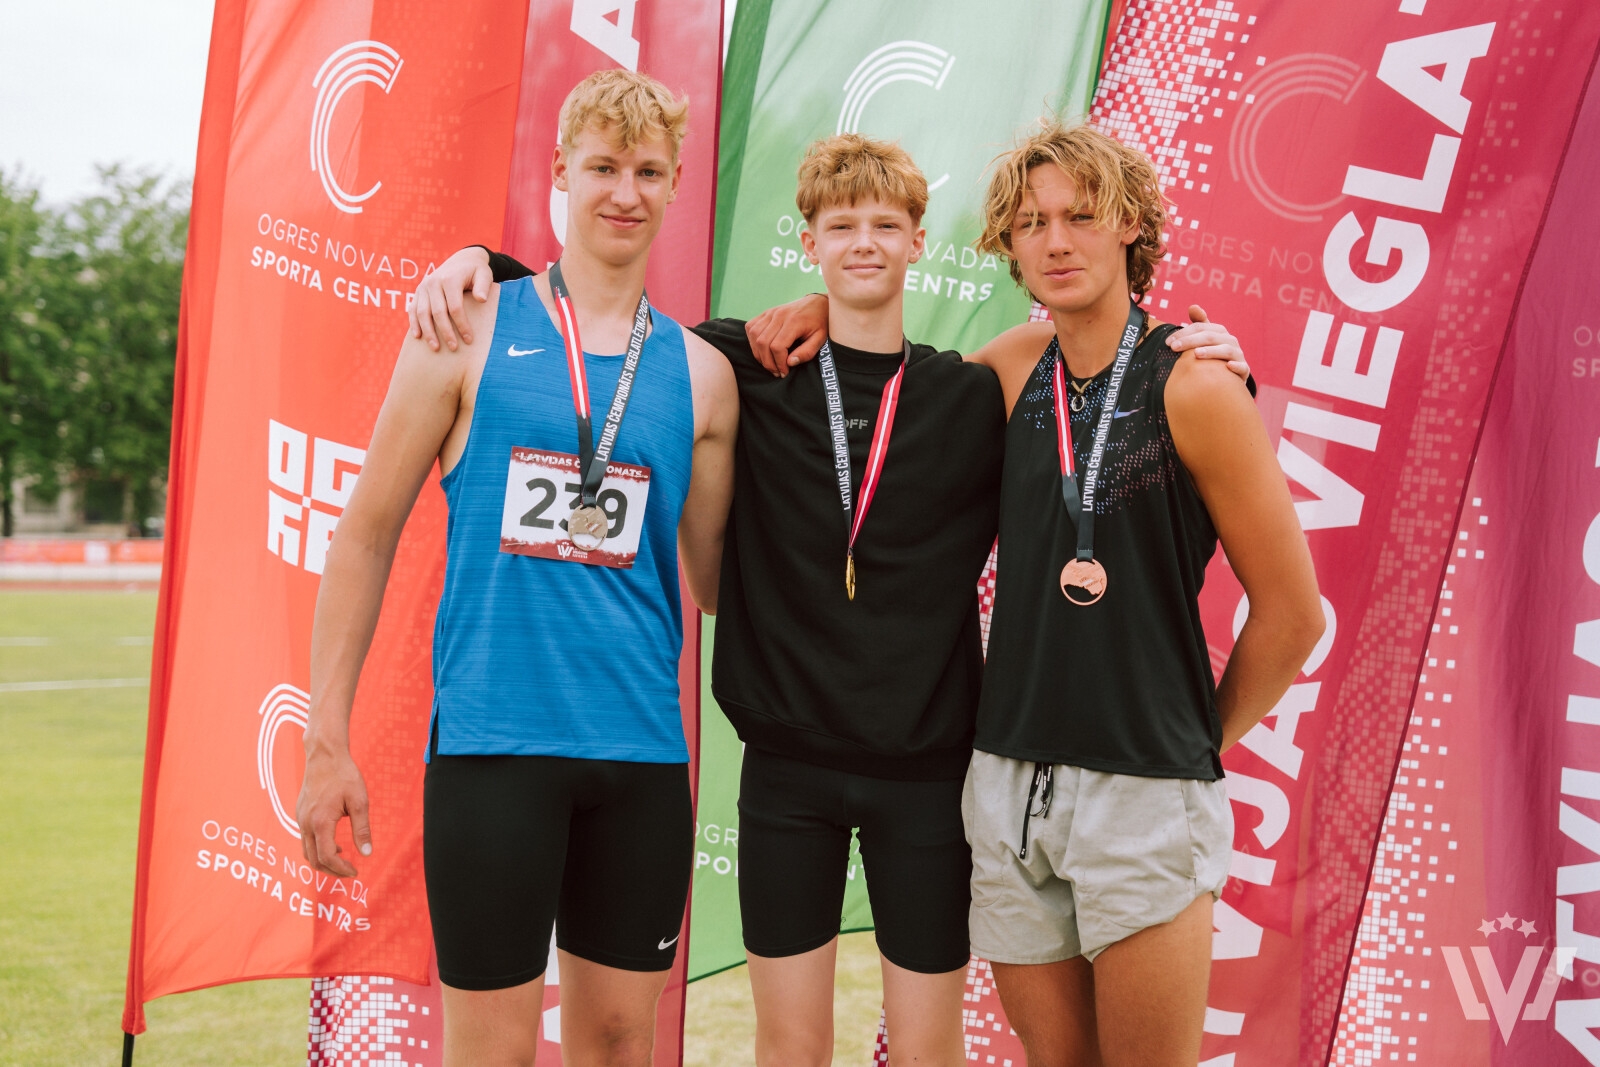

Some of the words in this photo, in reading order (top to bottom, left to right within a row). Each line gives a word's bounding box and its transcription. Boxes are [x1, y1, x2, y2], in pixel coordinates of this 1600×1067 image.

[258, 213, 320, 254] OGRES
[325, 238, 437, 281] NOVADA
[769, 246, 823, 276] SPO
[904, 270, 993, 302] ENTRS
[924, 240, 998, 272] VADA
[1277, 0, 1497, 531] VIEGLA
[250, 246, 323, 292] SPORTA
[333, 277, 416, 313] CENTR
[820, 338, 830, 356] 20
[1123, 324, 1140, 348] 2023
[606, 370, 633, 423] ČEMPIONĀTS
[1104, 348, 1132, 413] VIEGLATLĒTIKĀ
[595, 422, 618, 463] LATVIJAS
[830, 415, 849, 470] ČEMPIONĀTS
[1088, 412, 1111, 472] ČEMPIONĀTS
[838, 469, 851, 510] LATVIJAS
[1082, 470, 1098, 512] LATVIJAS
[196, 849, 283, 902] SPORTA
[289, 891, 371, 933] CENTRS
[202, 820, 277, 866] OGRES
[284, 856, 369, 908] NOVADA
